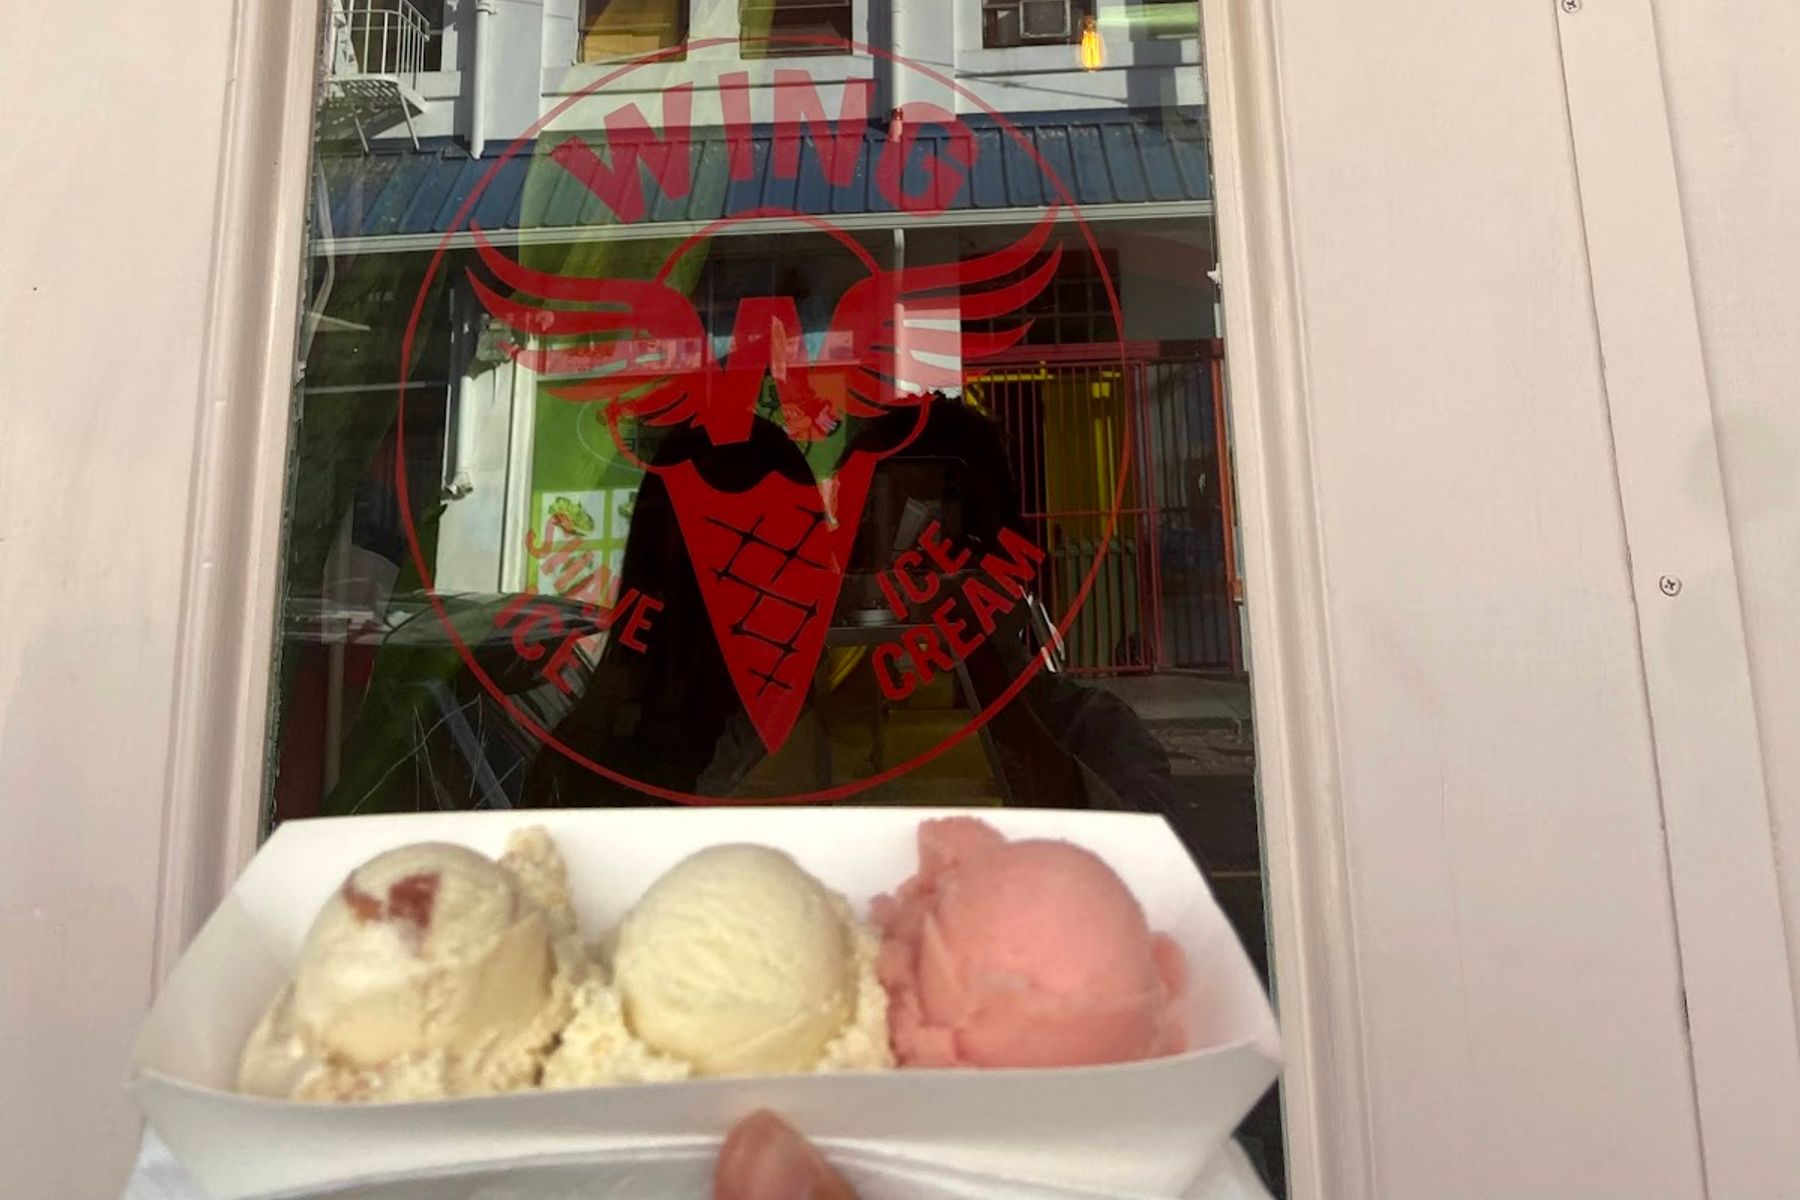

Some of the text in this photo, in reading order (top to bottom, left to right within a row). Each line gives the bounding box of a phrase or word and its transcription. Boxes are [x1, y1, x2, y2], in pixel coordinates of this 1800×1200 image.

[548, 69, 980, 225] WING
[493, 587, 598, 696] ICE
[524, 512, 665, 655] SHAVE
[871, 527, 1047, 700] CREAM
[874, 519, 972, 621] ICE
